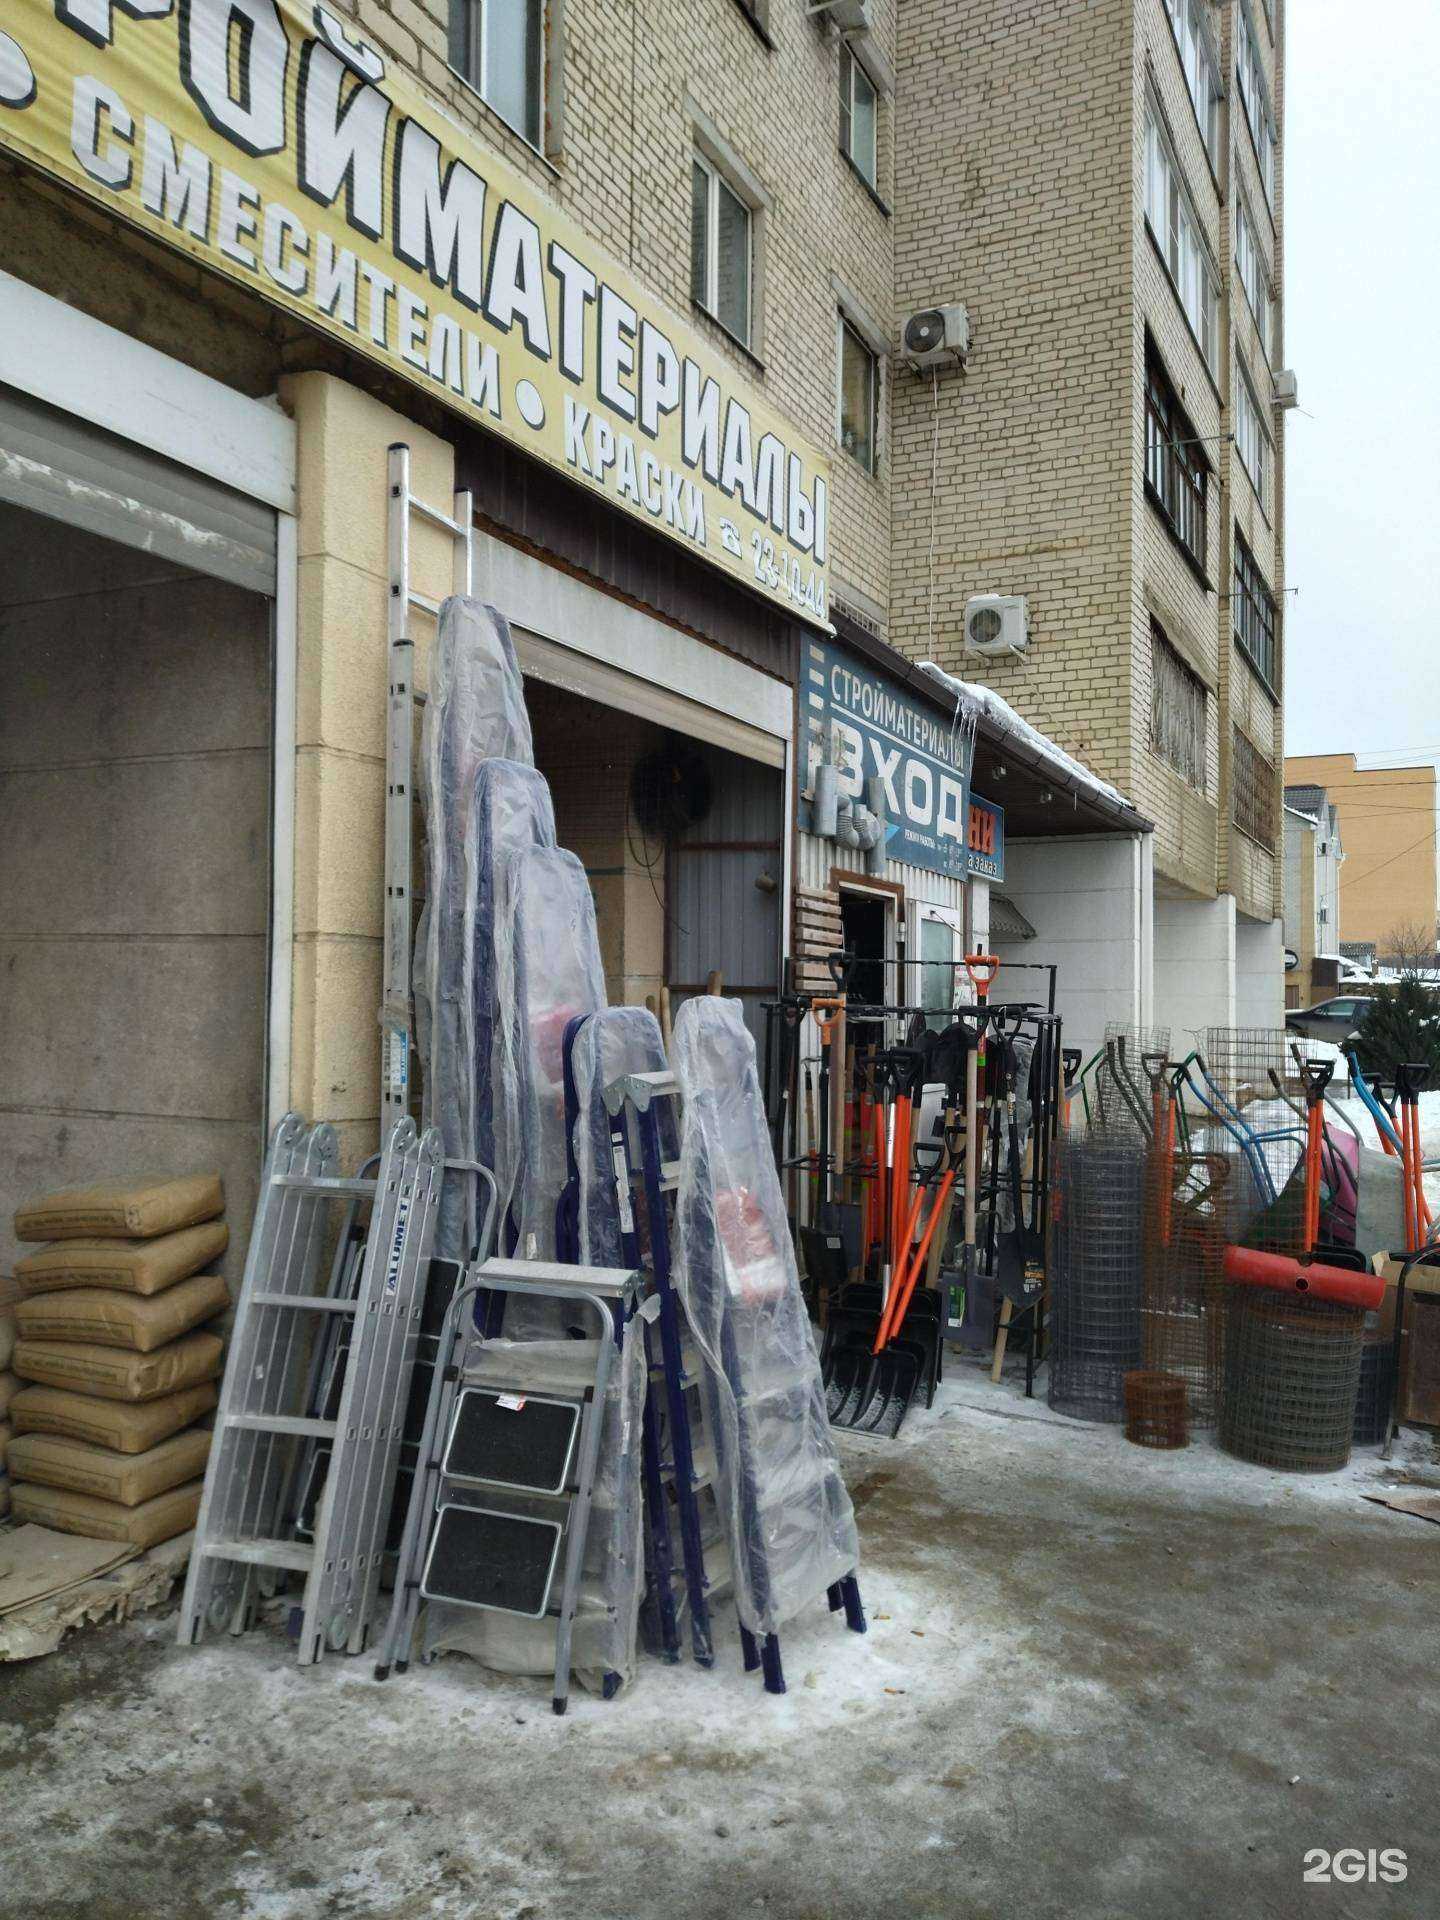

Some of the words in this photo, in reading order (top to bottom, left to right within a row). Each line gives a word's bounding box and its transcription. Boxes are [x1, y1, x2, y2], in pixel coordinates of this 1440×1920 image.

[53, 0, 826, 567] ОЙМАТЕРИАЛЫ
[71, 75, 501, 420] СМЕСИТЕЛИ
[564, 394, 707, 547] КРАСКИ
[831, 664, 964, 769] СТРОЙМАТЕРИАЛЫ
[831, 717, 963, 845] ВХОД
